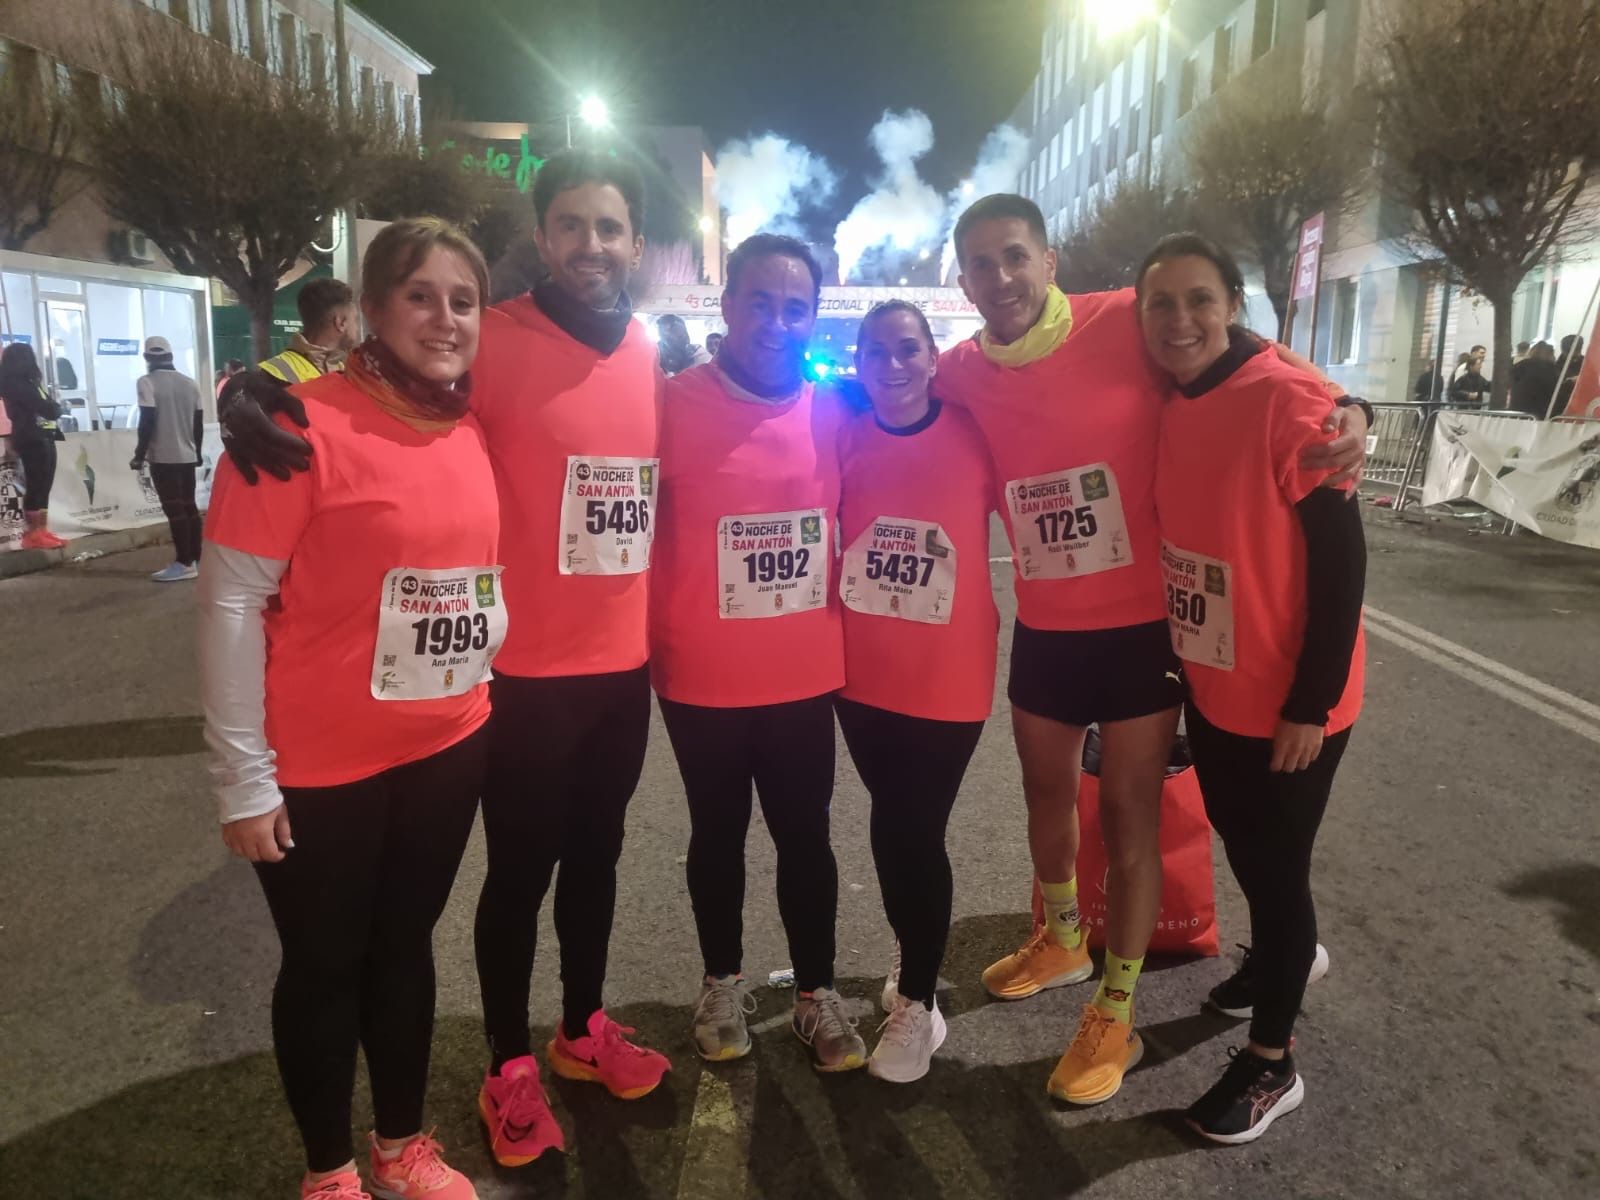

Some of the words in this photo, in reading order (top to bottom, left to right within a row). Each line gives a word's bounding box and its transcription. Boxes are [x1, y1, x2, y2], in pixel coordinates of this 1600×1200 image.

[702, 298, 721, 308] CA
[818, 299, 864, 311] CIONAL
[931, 300, 958, 312] SAN
[960, 300, 977, 312] AN
[592, 470, 626, 482] NOCHE
[626, 471, 634, 482] DE
[576, 484, 603, 497] SAN
[1029, 484, 1057, 499] NOCHE
[1059, 482, 1070, 493] DE
[1021, 502, 1040, 514] SAN
[586, 500, 649, 535] 5436
[745, 525, 778, 536] NOCHE
[781, 524, 792, 534] DE
[1035, 505, 1097, 544] 1725
[616, 537, 633, 545] David
[904, 530, 917, 541] DE
[732, 539, 755, 551] SAN
[743, 548, 809, 583] 1992
[866, 550, 935, 587] 5437
[1185, 564, 1196, 575] DE
[420, 583, 456, 598] NOCHE
[457, 582, 468, 595] DE
[757, 584, 773, 593] Juan
[775, 581, 798, 590] Manuel
[878, 583, 891, 592] Rita
[400, 599, 430, 613] SAN
[412, 612, 489, 655] 1993
[432, 658, 446, 667] Ana
